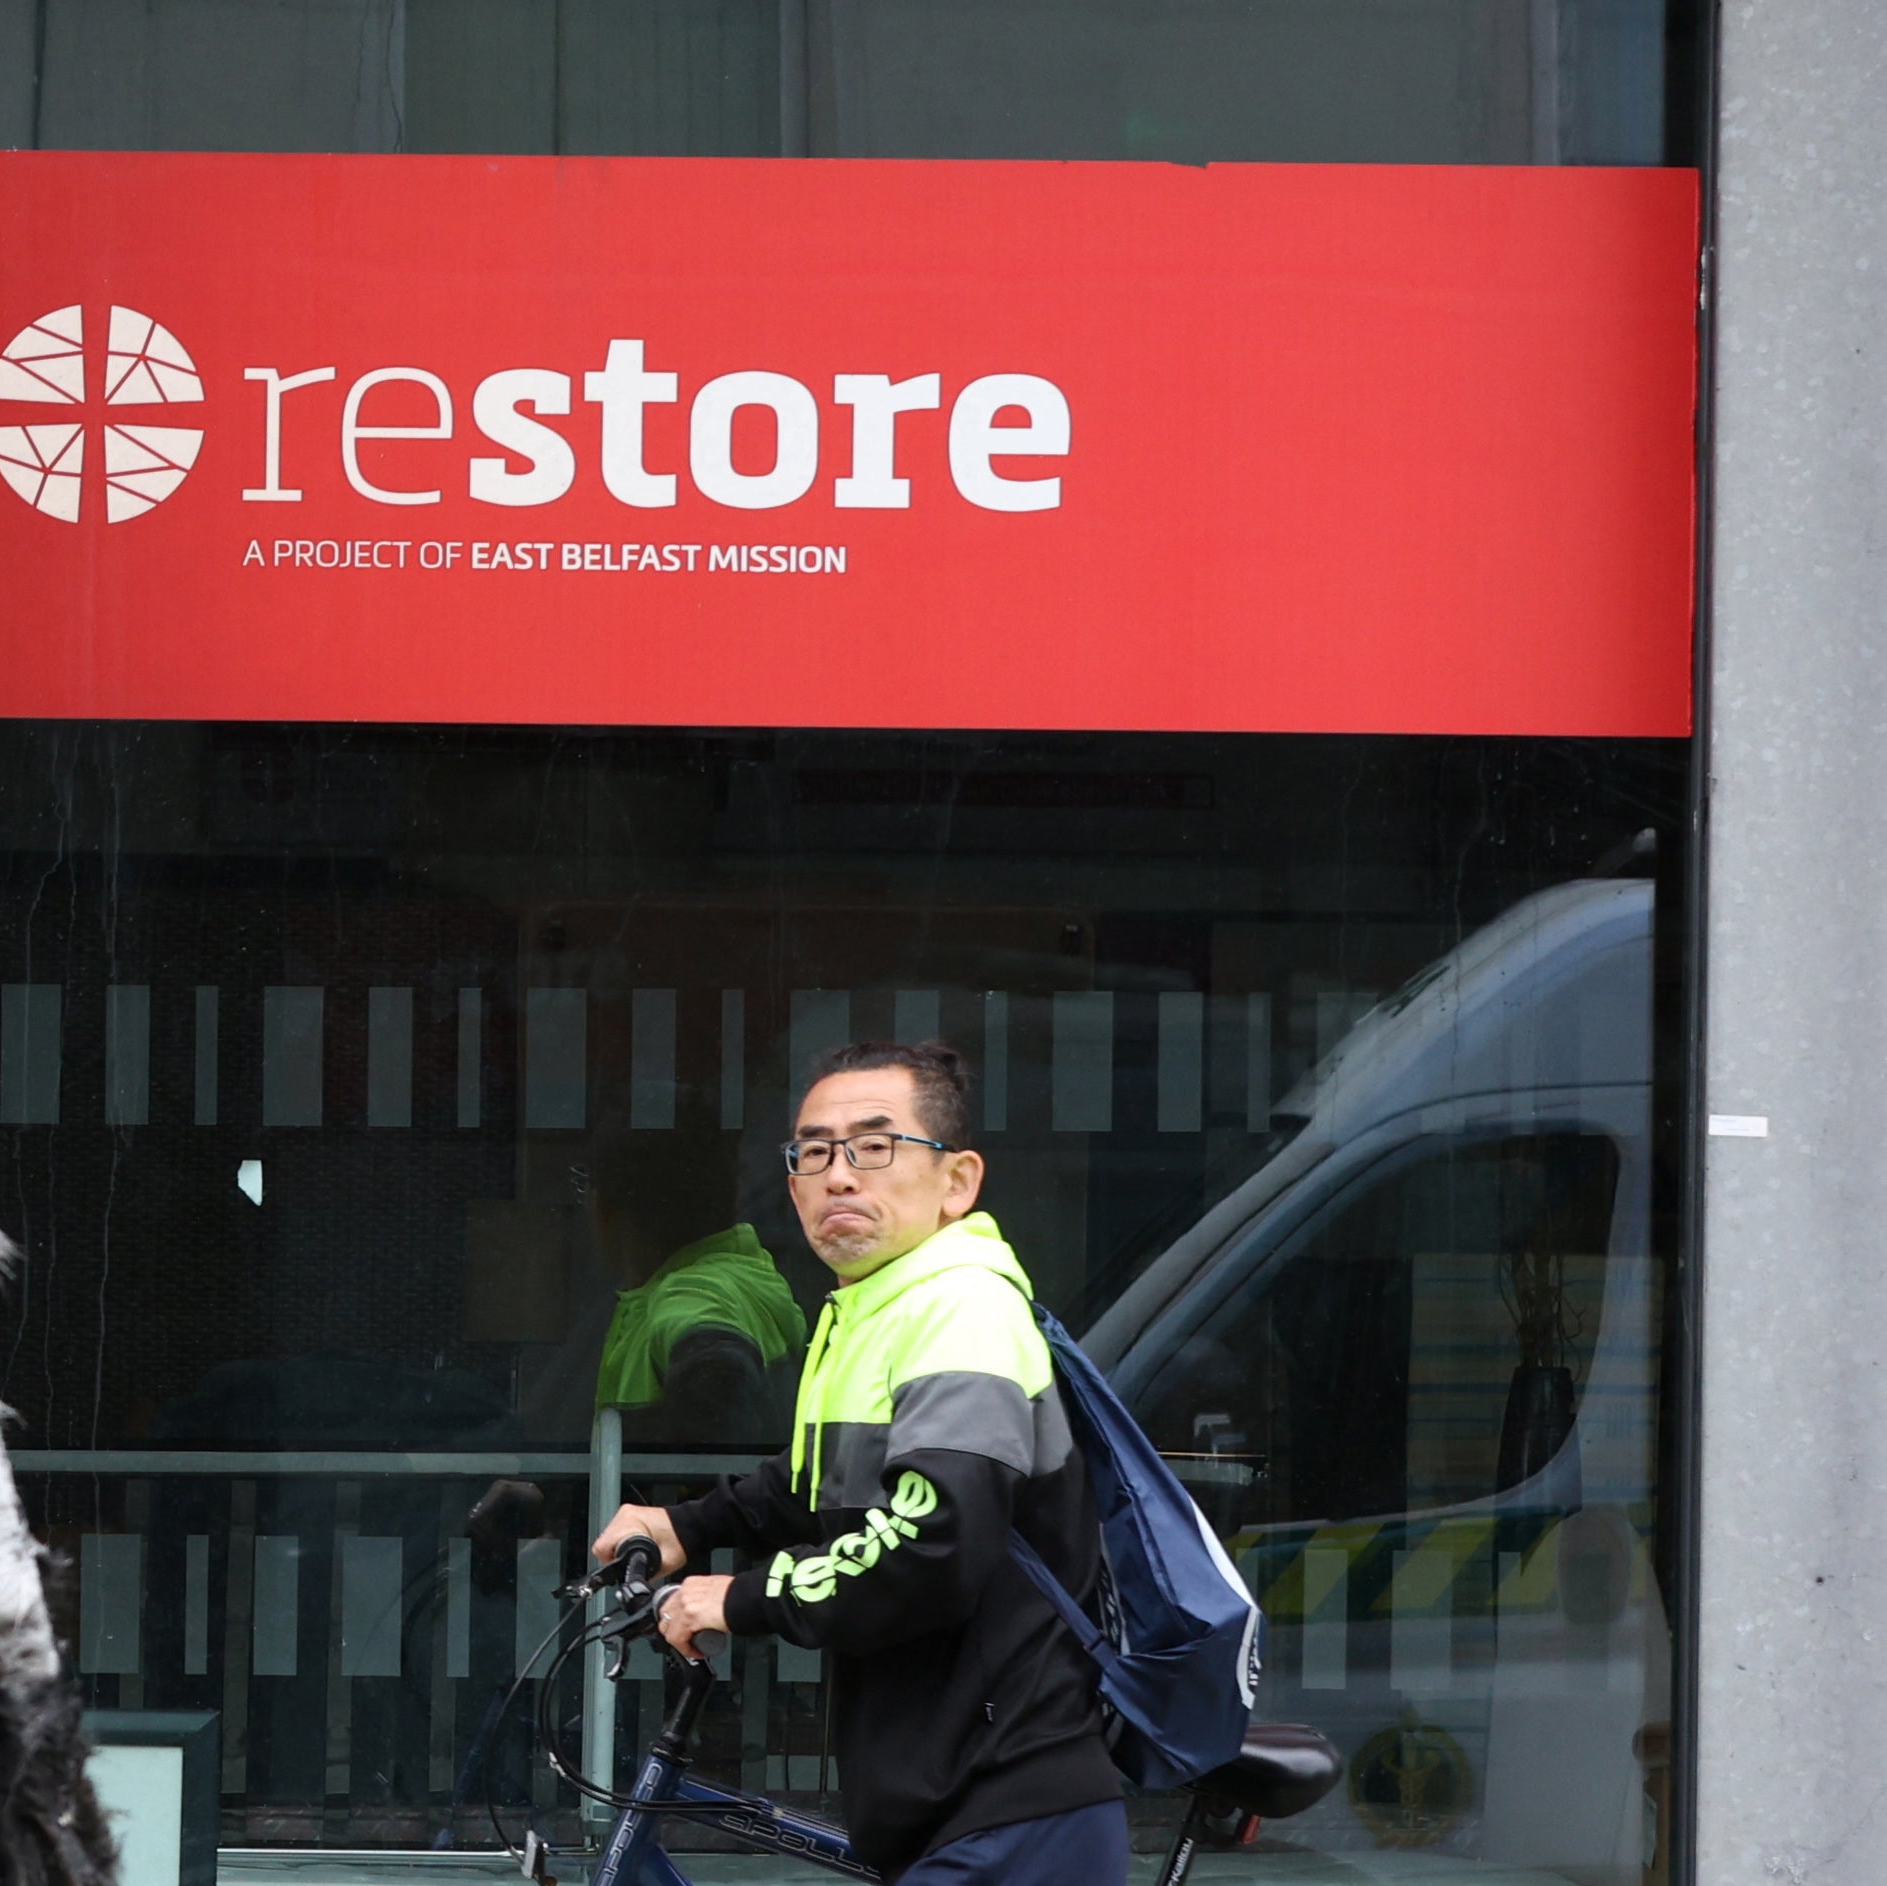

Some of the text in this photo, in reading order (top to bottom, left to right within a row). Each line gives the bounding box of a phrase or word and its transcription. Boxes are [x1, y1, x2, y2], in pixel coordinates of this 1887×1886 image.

[242, 339, 1071, 513] restore
[243, 540, 847, 573] A PROJECT OF EAST BELFAST MISSION
